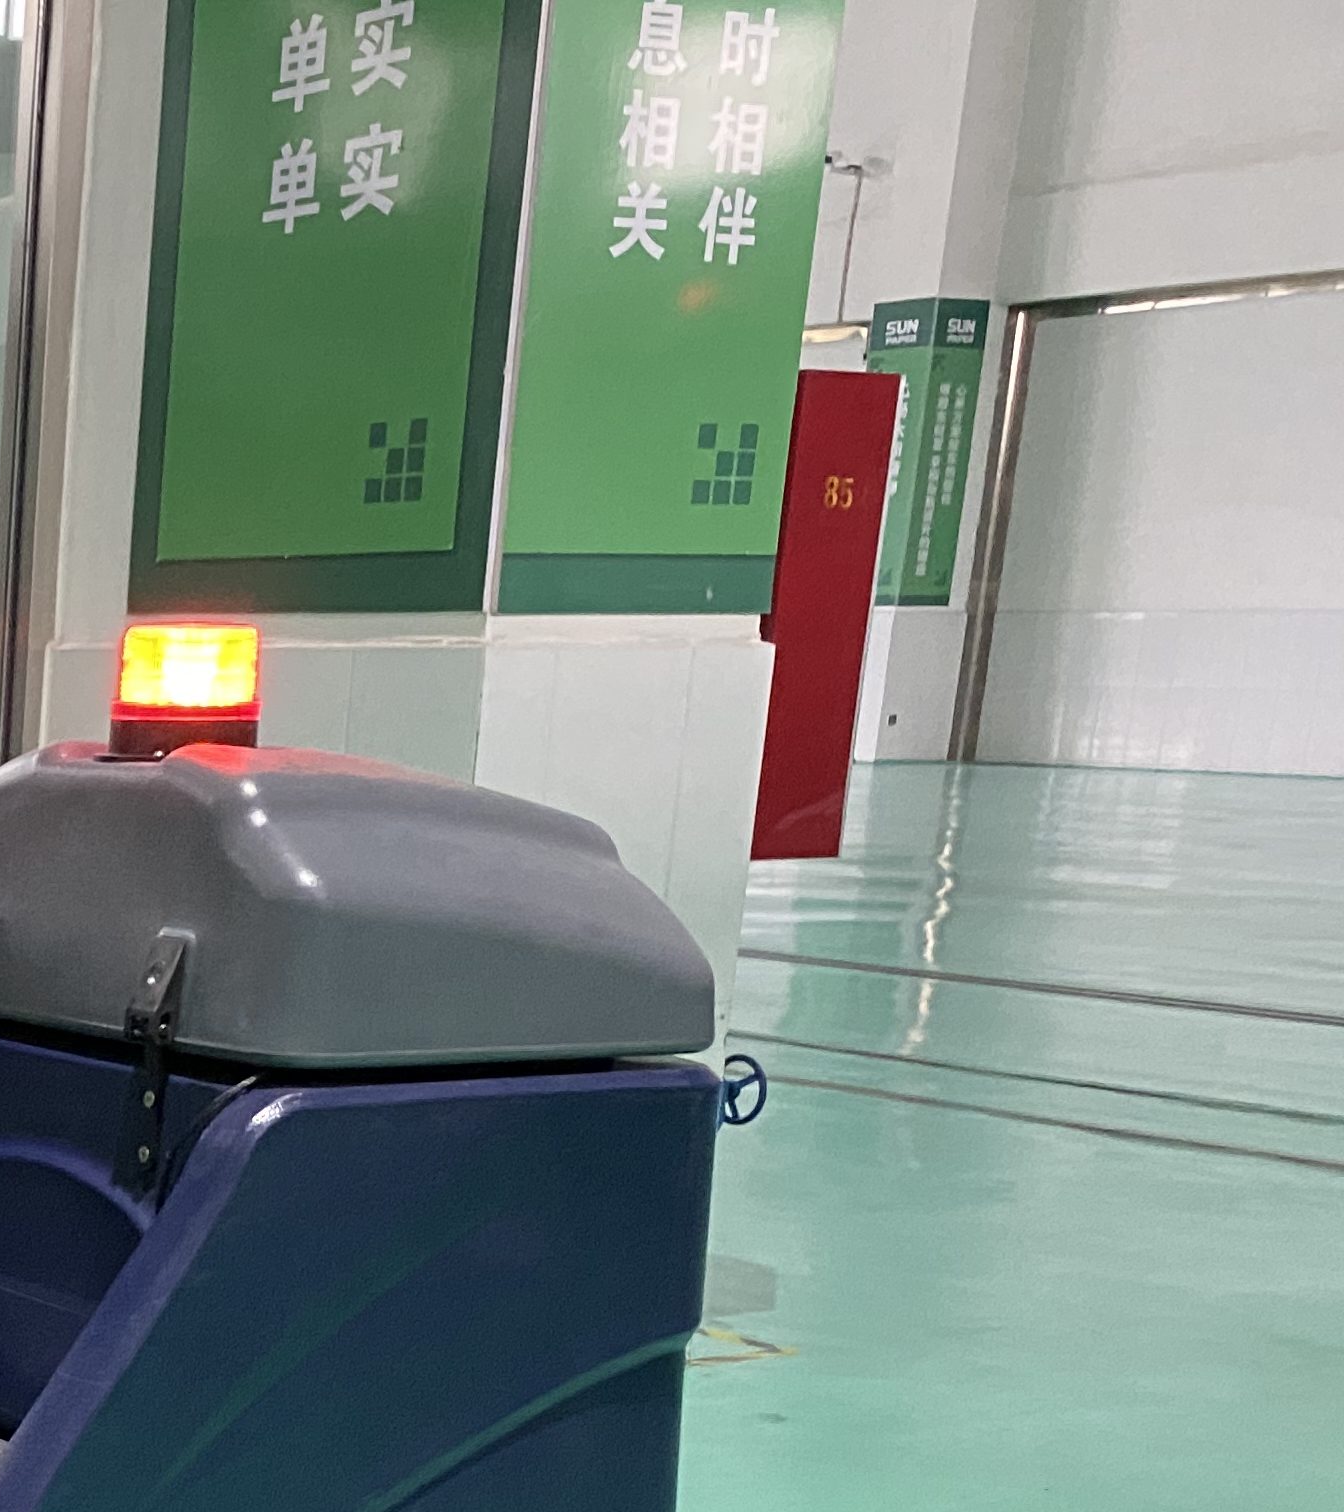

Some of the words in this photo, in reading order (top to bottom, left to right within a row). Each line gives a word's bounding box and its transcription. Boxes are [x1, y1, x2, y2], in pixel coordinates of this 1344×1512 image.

[885, 319, 919, 336] SUN
[947, 318, 976, 334] SUN
[823, 475, 854, 510] 85
